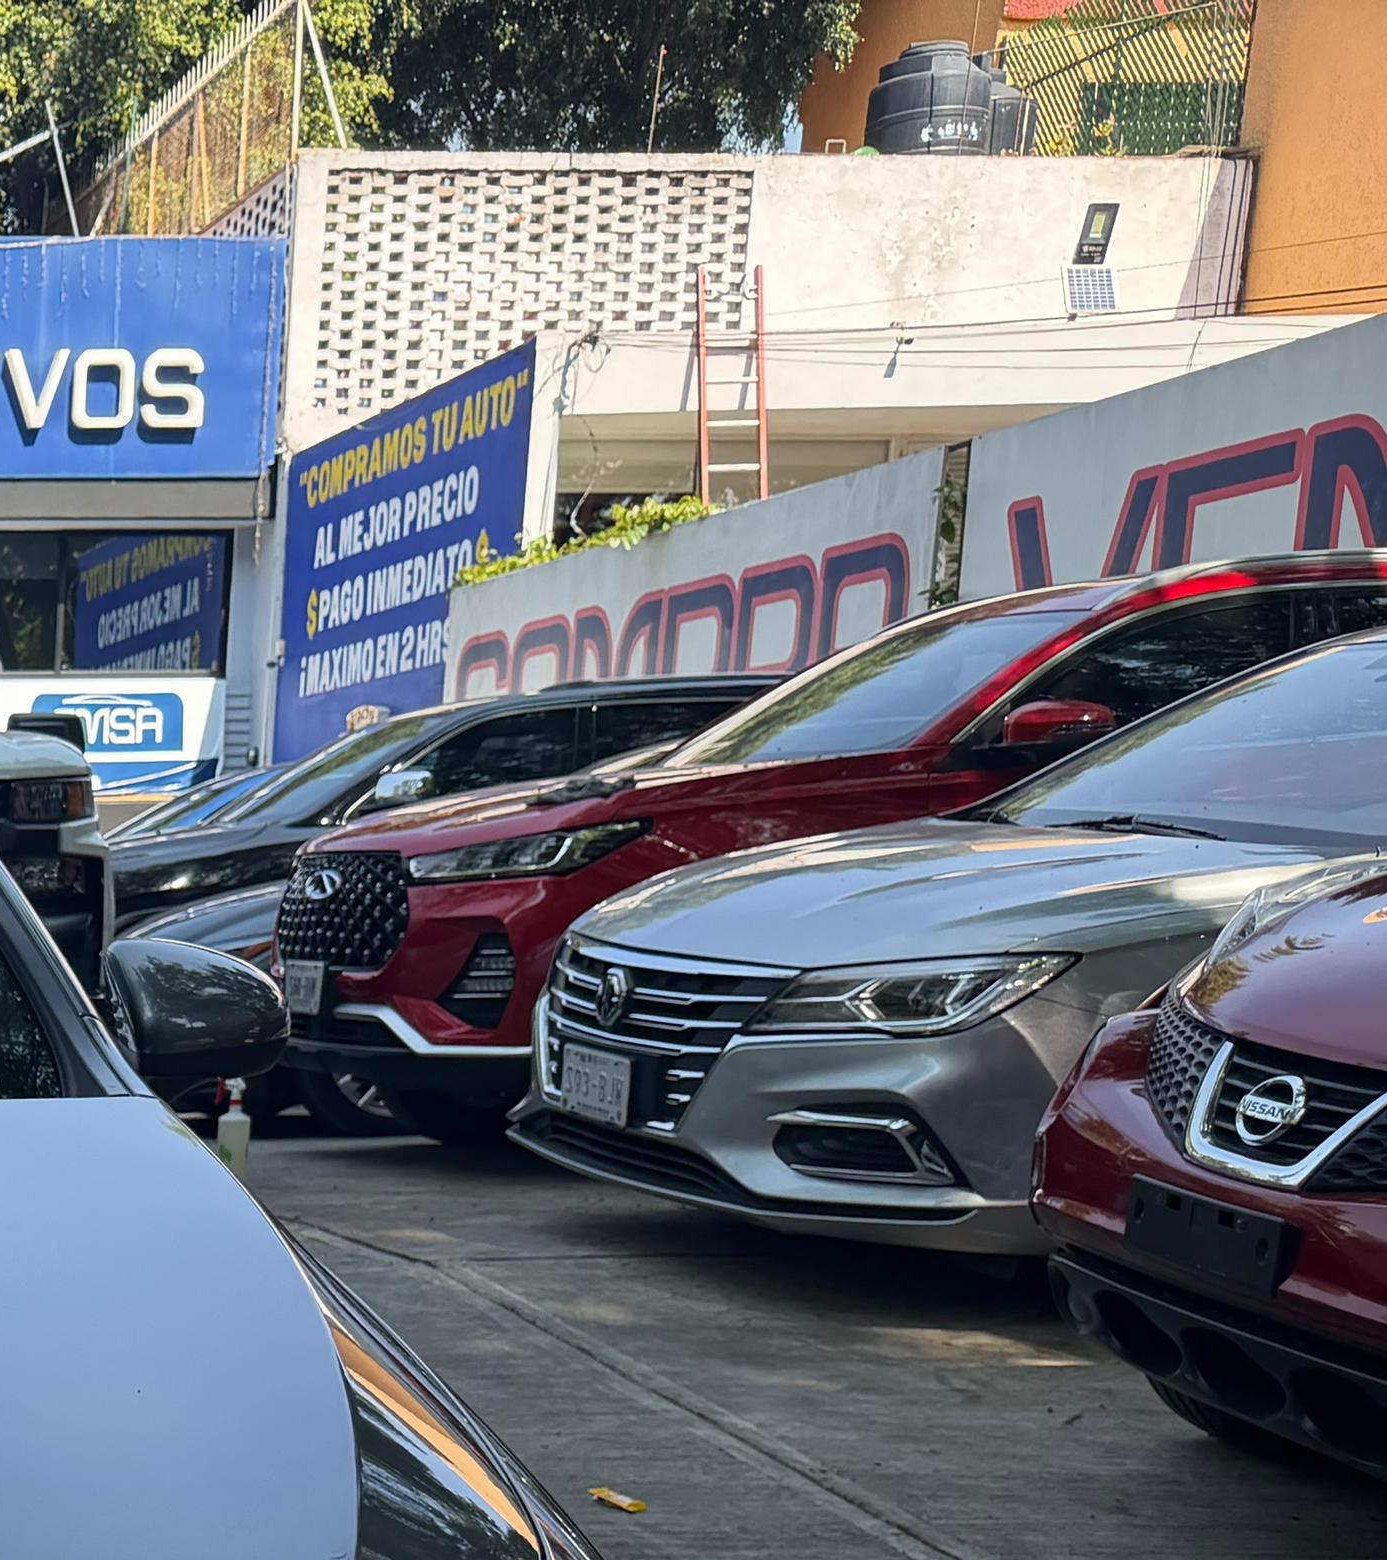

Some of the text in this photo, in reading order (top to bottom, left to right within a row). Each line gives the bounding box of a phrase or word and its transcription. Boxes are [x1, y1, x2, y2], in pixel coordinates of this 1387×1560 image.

[431, 403, 458, 455] TU
[314, 465, 480, 569] AL MEJOR PRECIO
[366, 538, 473, 616] INMEDIATO
[374, 629, 400, 679] EN
[399, 625, 414, 673] 2
[54, 706, 164, 744] MSA
[1241, 1098, 1290, 1120] NISSAN
